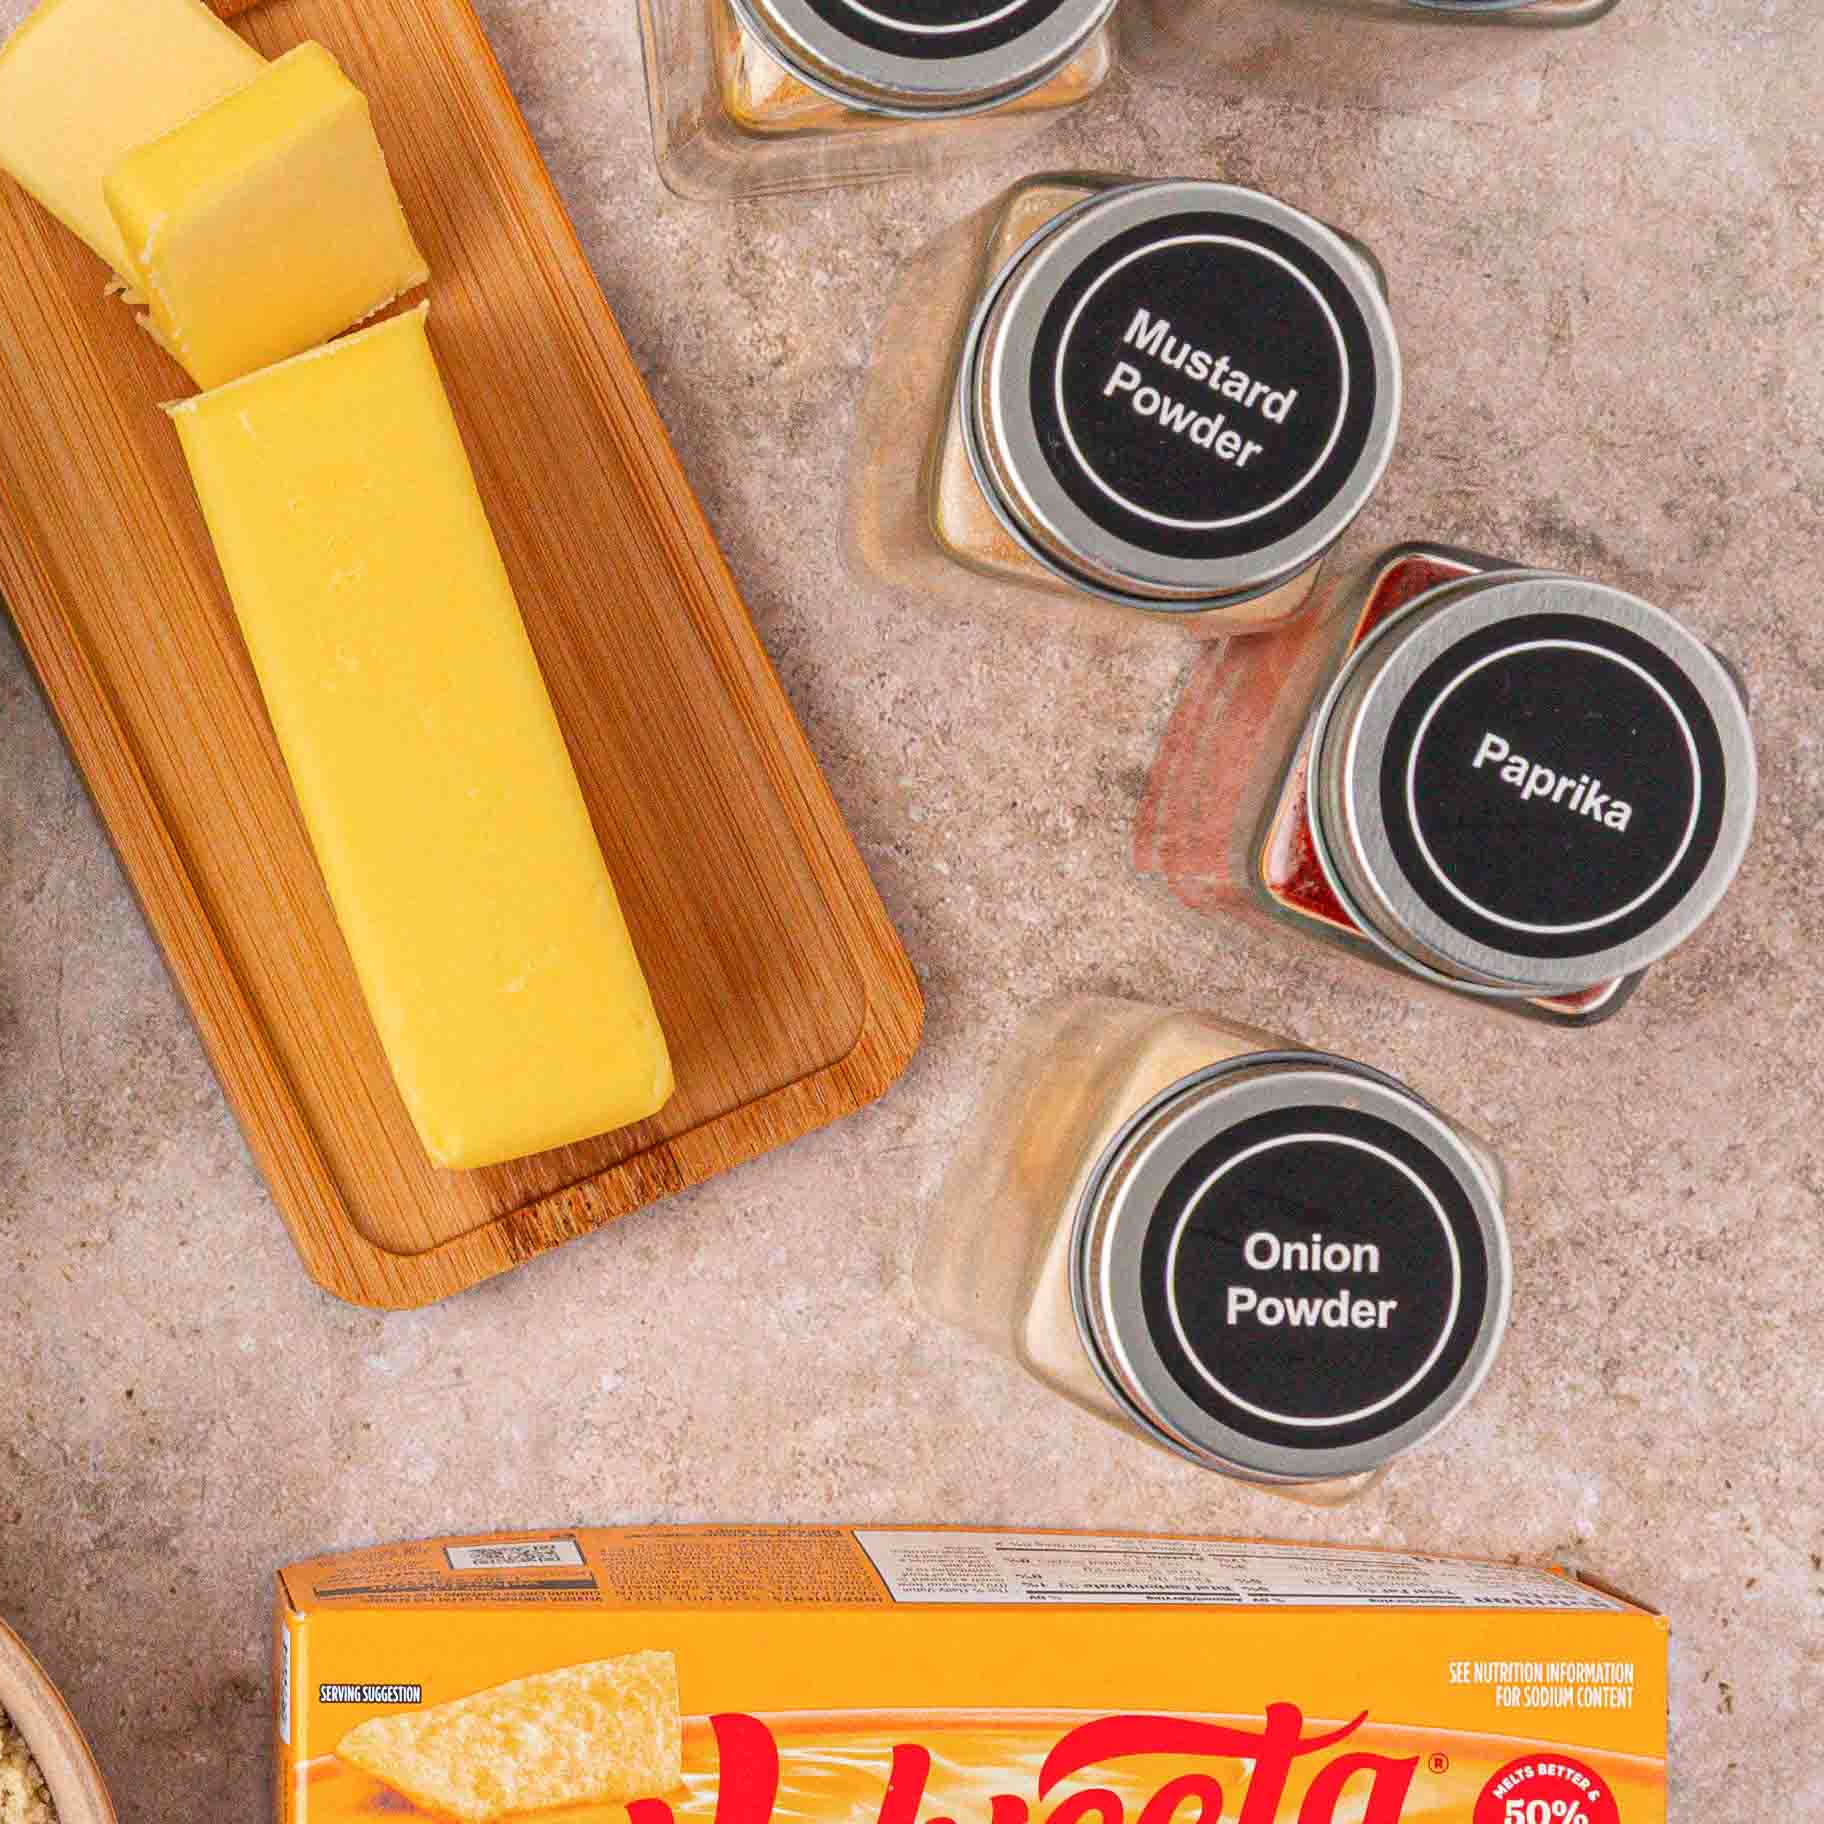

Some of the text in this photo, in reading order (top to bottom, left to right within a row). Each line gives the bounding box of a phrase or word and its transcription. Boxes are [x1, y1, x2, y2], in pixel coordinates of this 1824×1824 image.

[1122, 307, 1297, 425] Mustard
[1102, 361, 1265, 469] Powder
[1471, 731, 1633, 833] Paprika
[1243, 1231, 1381, 1274] Onion
[1226, 1286, 1398, 1329] Powder
[320, 1685, 421, 1702] SERVING SUGGESTION
[1449, 1662, 1634, 1684] SEE NUTRITION INFORMATION
[1496, 1685, 1633, 1708] FOR SODIUM CONTENT
[1492, 1762, 1592, 1800] MELTS BETTER
